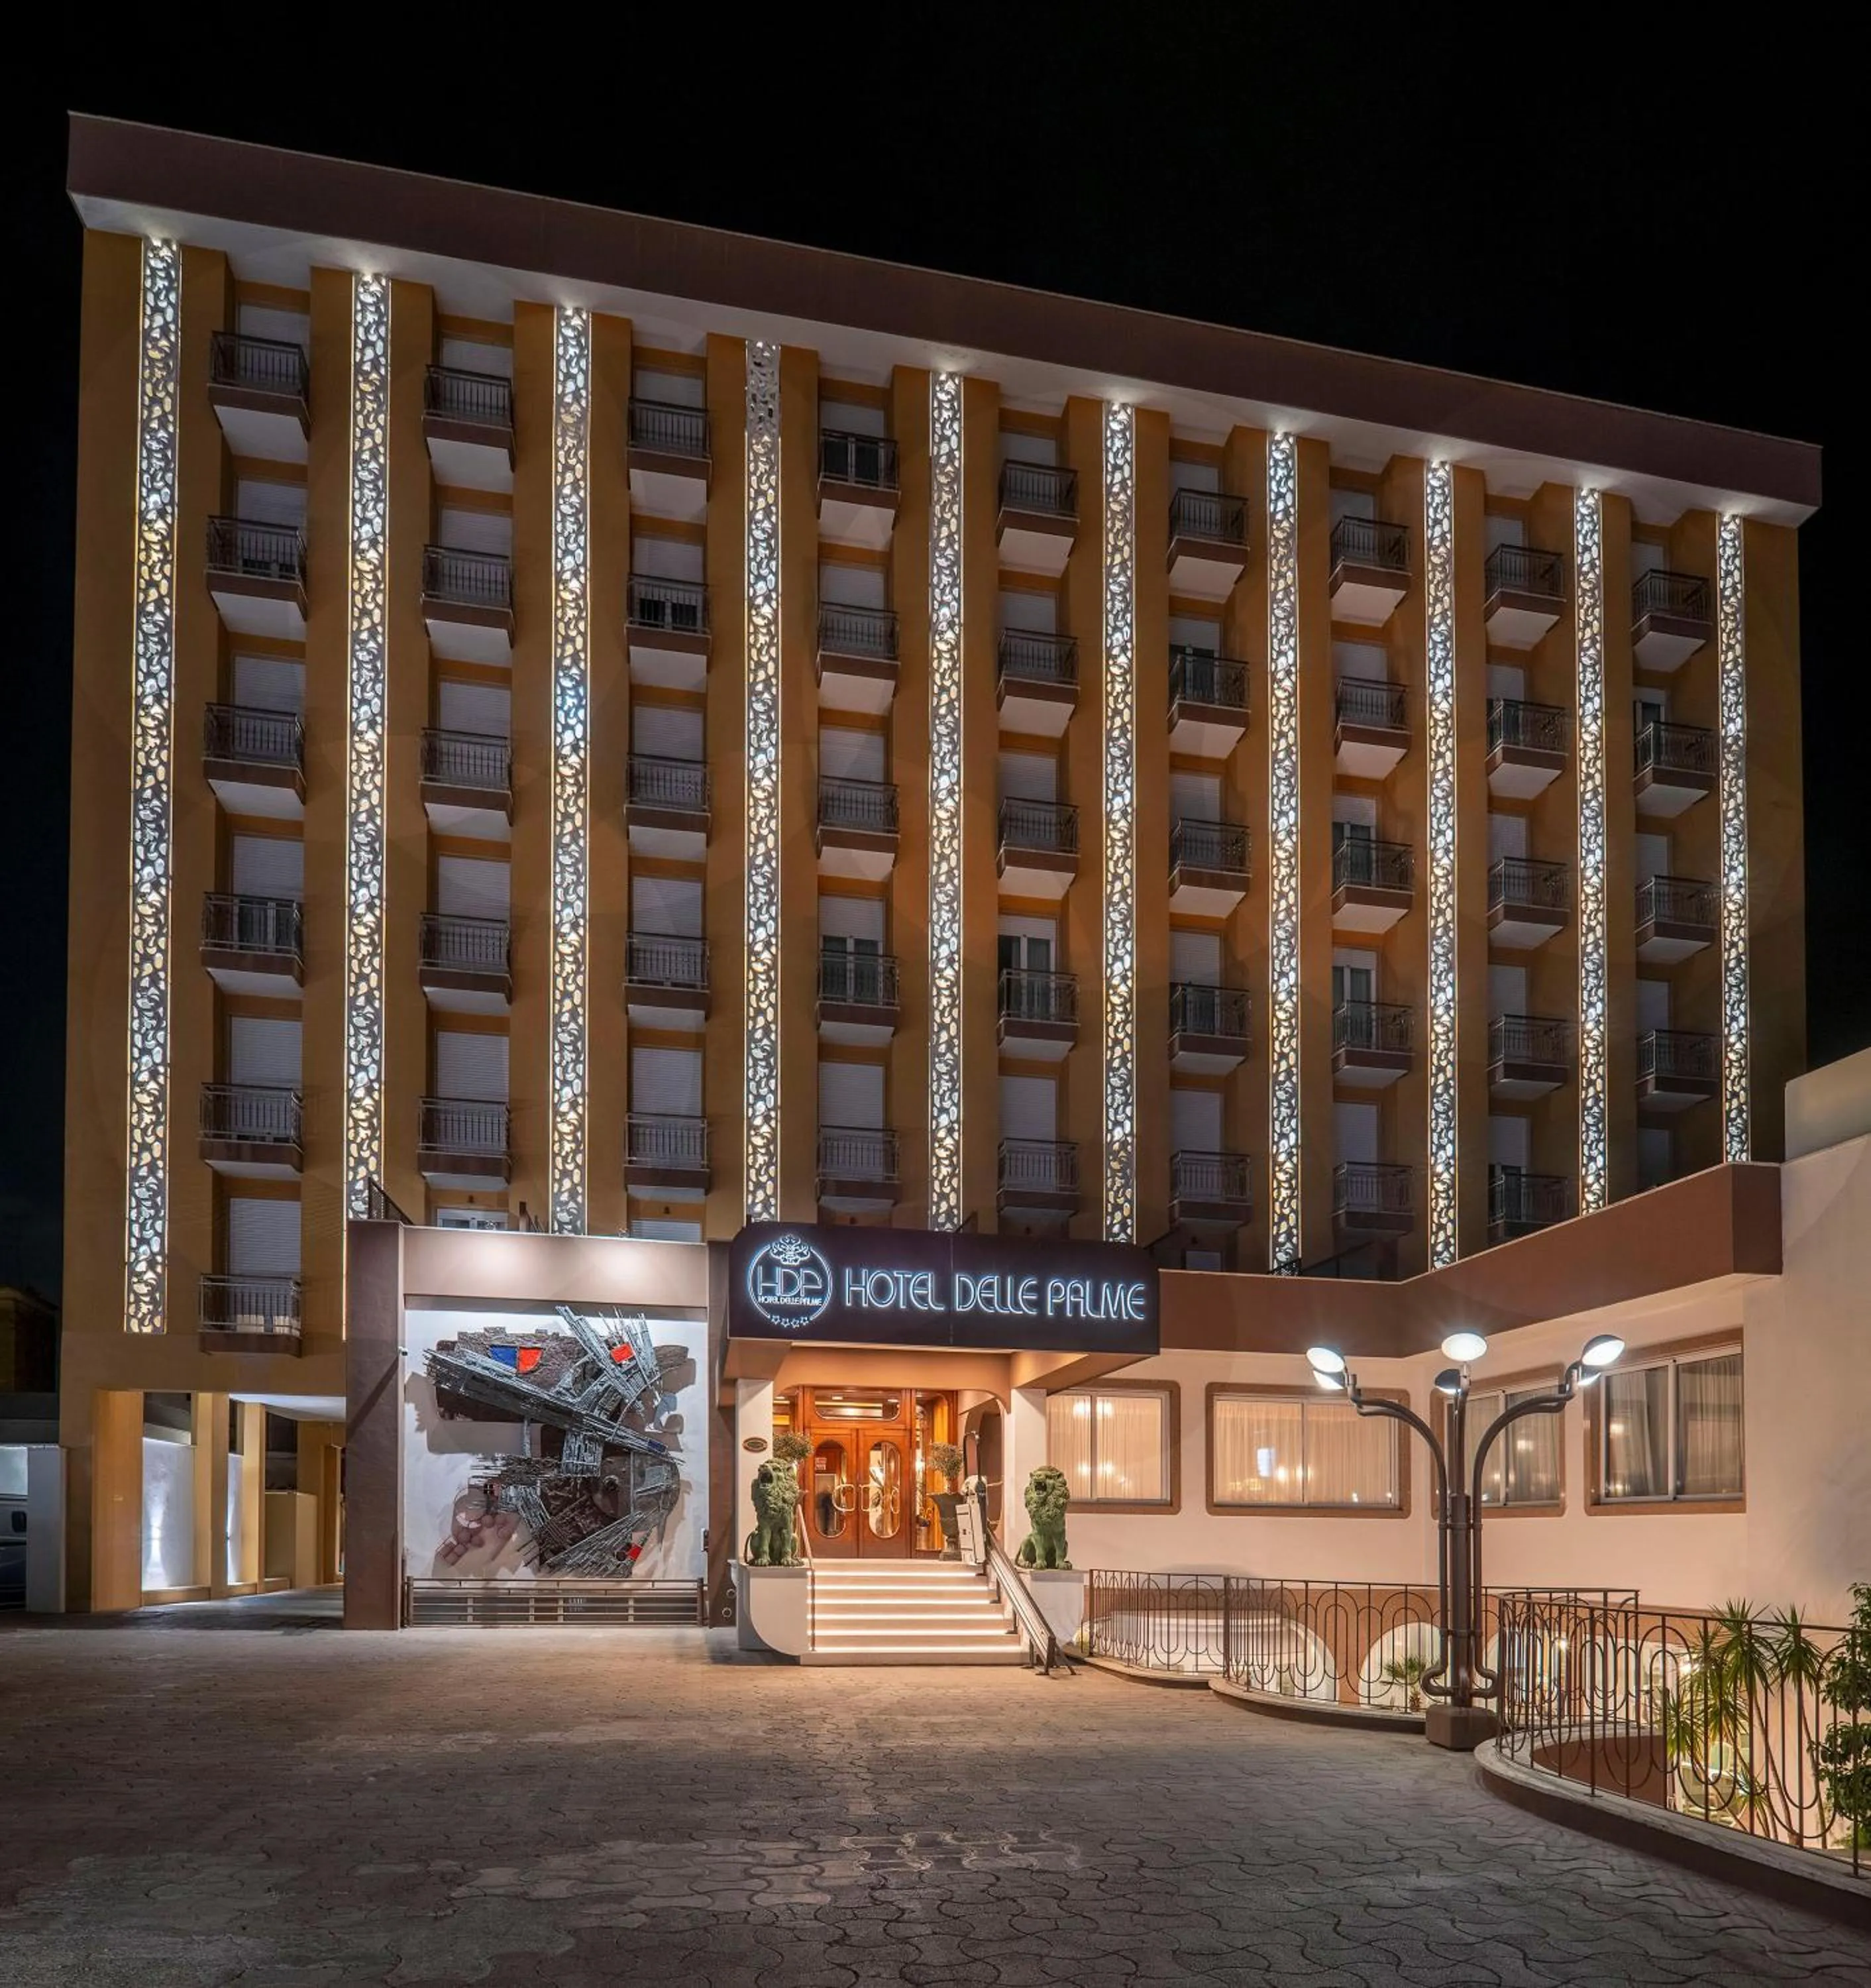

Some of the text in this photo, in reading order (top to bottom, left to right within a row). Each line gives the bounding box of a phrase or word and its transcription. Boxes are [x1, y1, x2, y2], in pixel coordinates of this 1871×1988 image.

[757, 1265, 822, 1297] HDP
[845, 1268, 1146, 1320] HOTEL DELLE PALME
